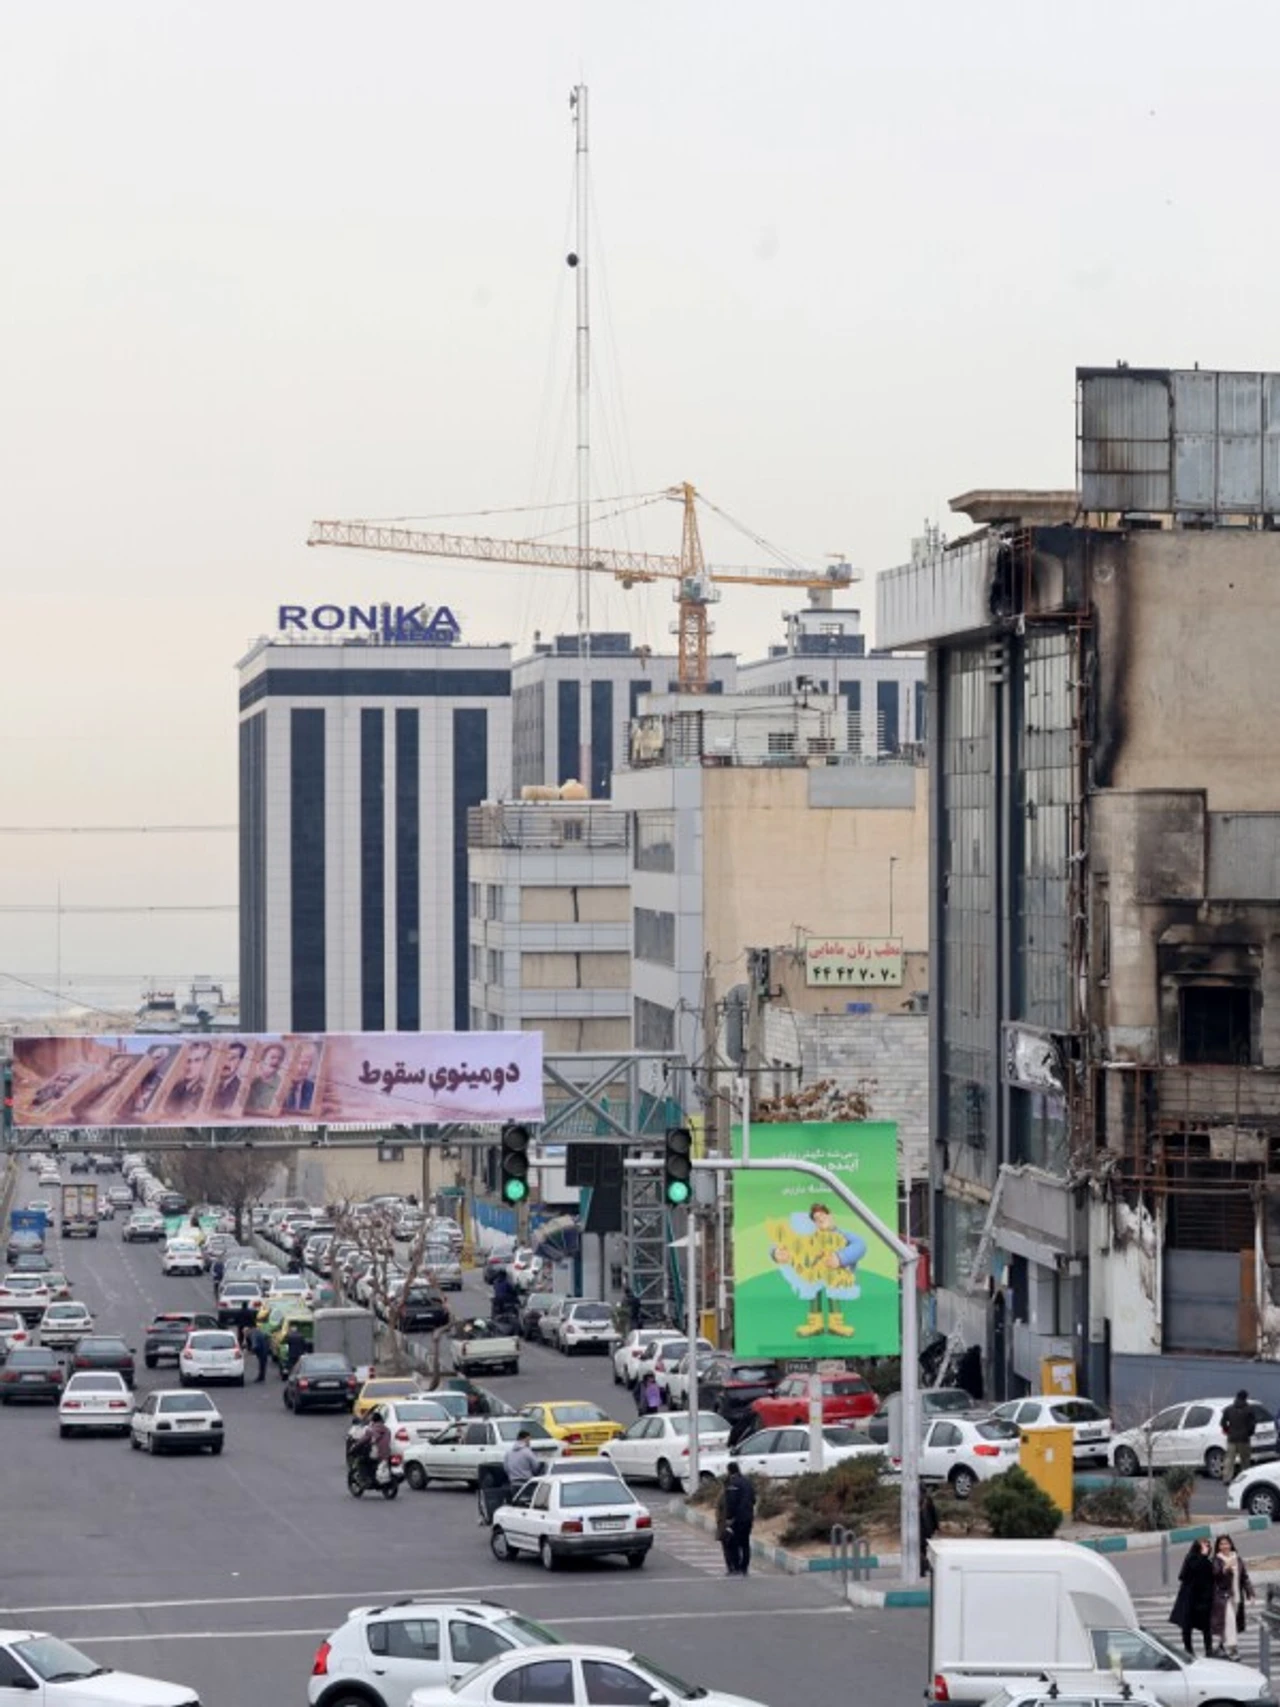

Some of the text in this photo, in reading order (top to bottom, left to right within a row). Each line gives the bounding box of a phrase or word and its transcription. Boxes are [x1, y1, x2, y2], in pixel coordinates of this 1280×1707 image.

[279, 603, 461, 633] RONIKA
[357, 1059, 521, 1097] دومینوی سقوط
